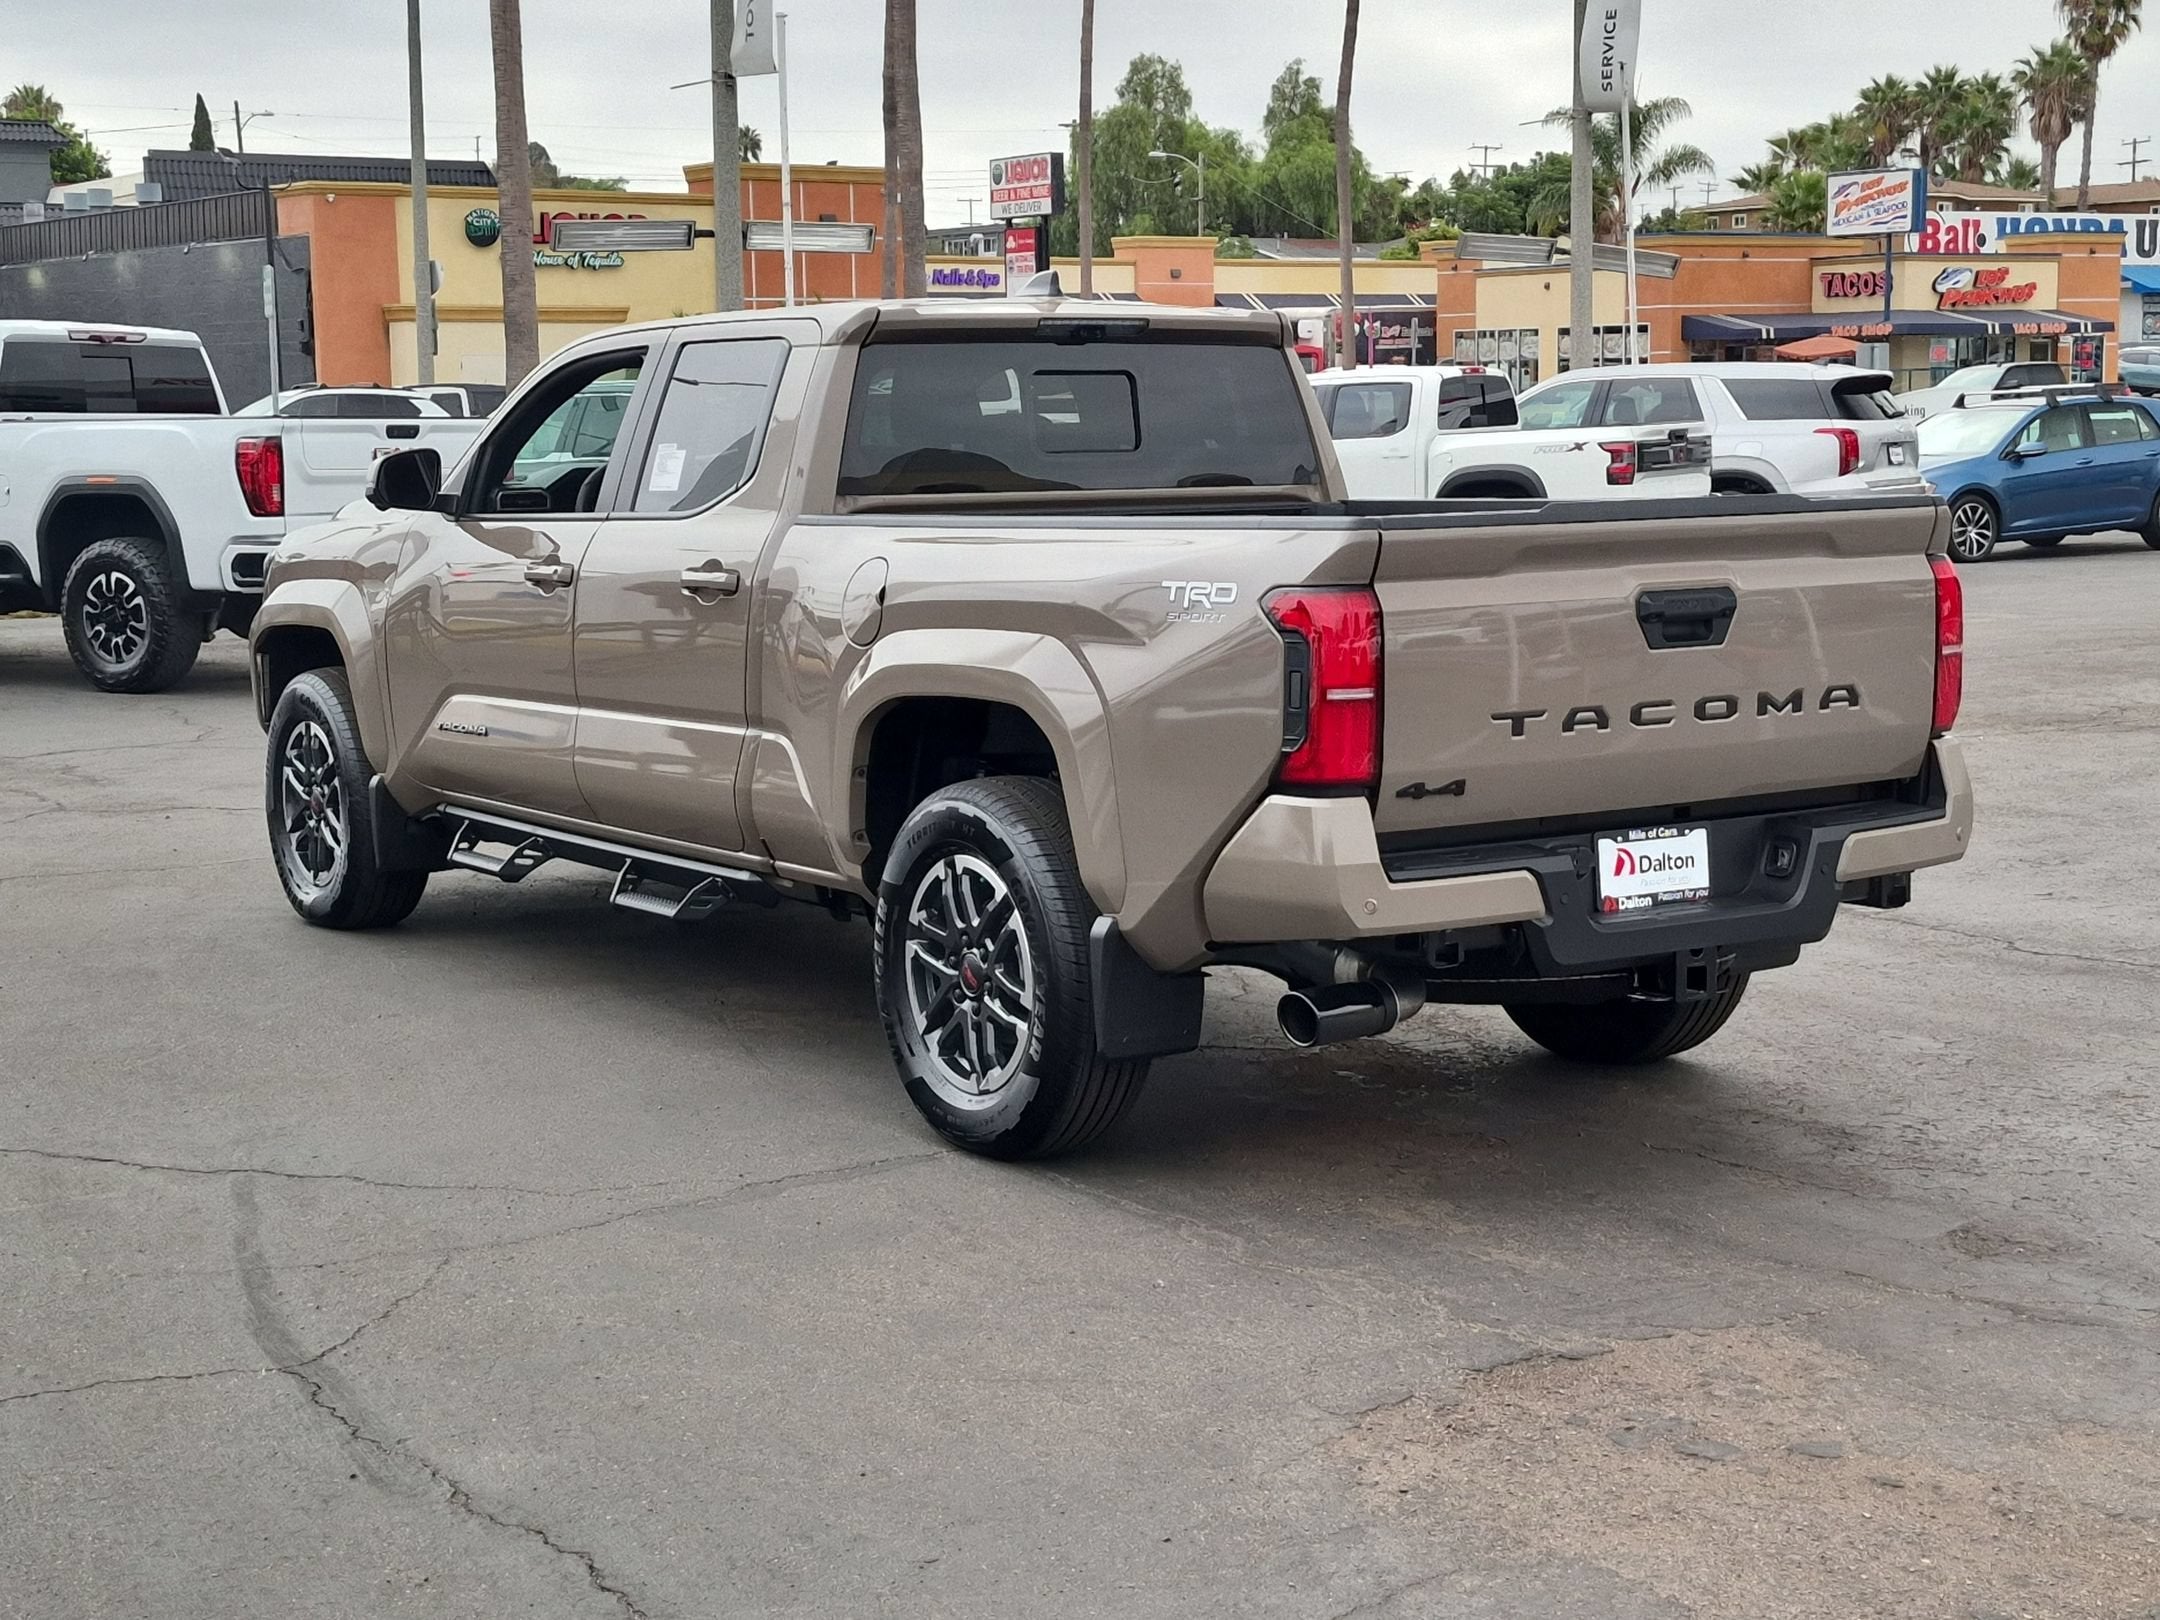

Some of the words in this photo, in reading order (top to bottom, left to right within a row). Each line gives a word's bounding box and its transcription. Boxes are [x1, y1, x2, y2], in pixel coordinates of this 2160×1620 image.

[1601, 9, 1617, 92] SERVICE
[1001, 204, 1012, 215] WE
[1014, 201, 1042, 213] DELIVER
[1873, 200, 1908, 216] SEAFOOD
[473, 218, 492, 227] CITY
[567, 253, 580, 269] of
[583, 251, 624, 270] Tequila
[932, 269, 964, 286] Nails
[965, 270, 974, 285] &
[976, 269, 1000, 288] Spa
[1820, 271, 1888, 298] TACOS
[1831, 325, 1859, 337] TACO
[1861, 323, 1893, 336] SHOP
[2013, 323, 2038, 334] TACO
[2040, 322, 2068, 333] SHOP
[1161, 580, 1238, 609] TRD
[1166, 611, 1227, 623] SPORT
[1490, 682, 1862, 739] TACOMA
[436, 721, 488, 736] TACOMA
[1647, 828, 1656, 838] of
[1658, 826, 1678, 837] Cars
[1639, 852, 1695, 873] Dalton
[1684, 887, 1695, 898] for
[1695, 887, 1709, 899] you
[1619, 896, 1653, 910] Dalton
